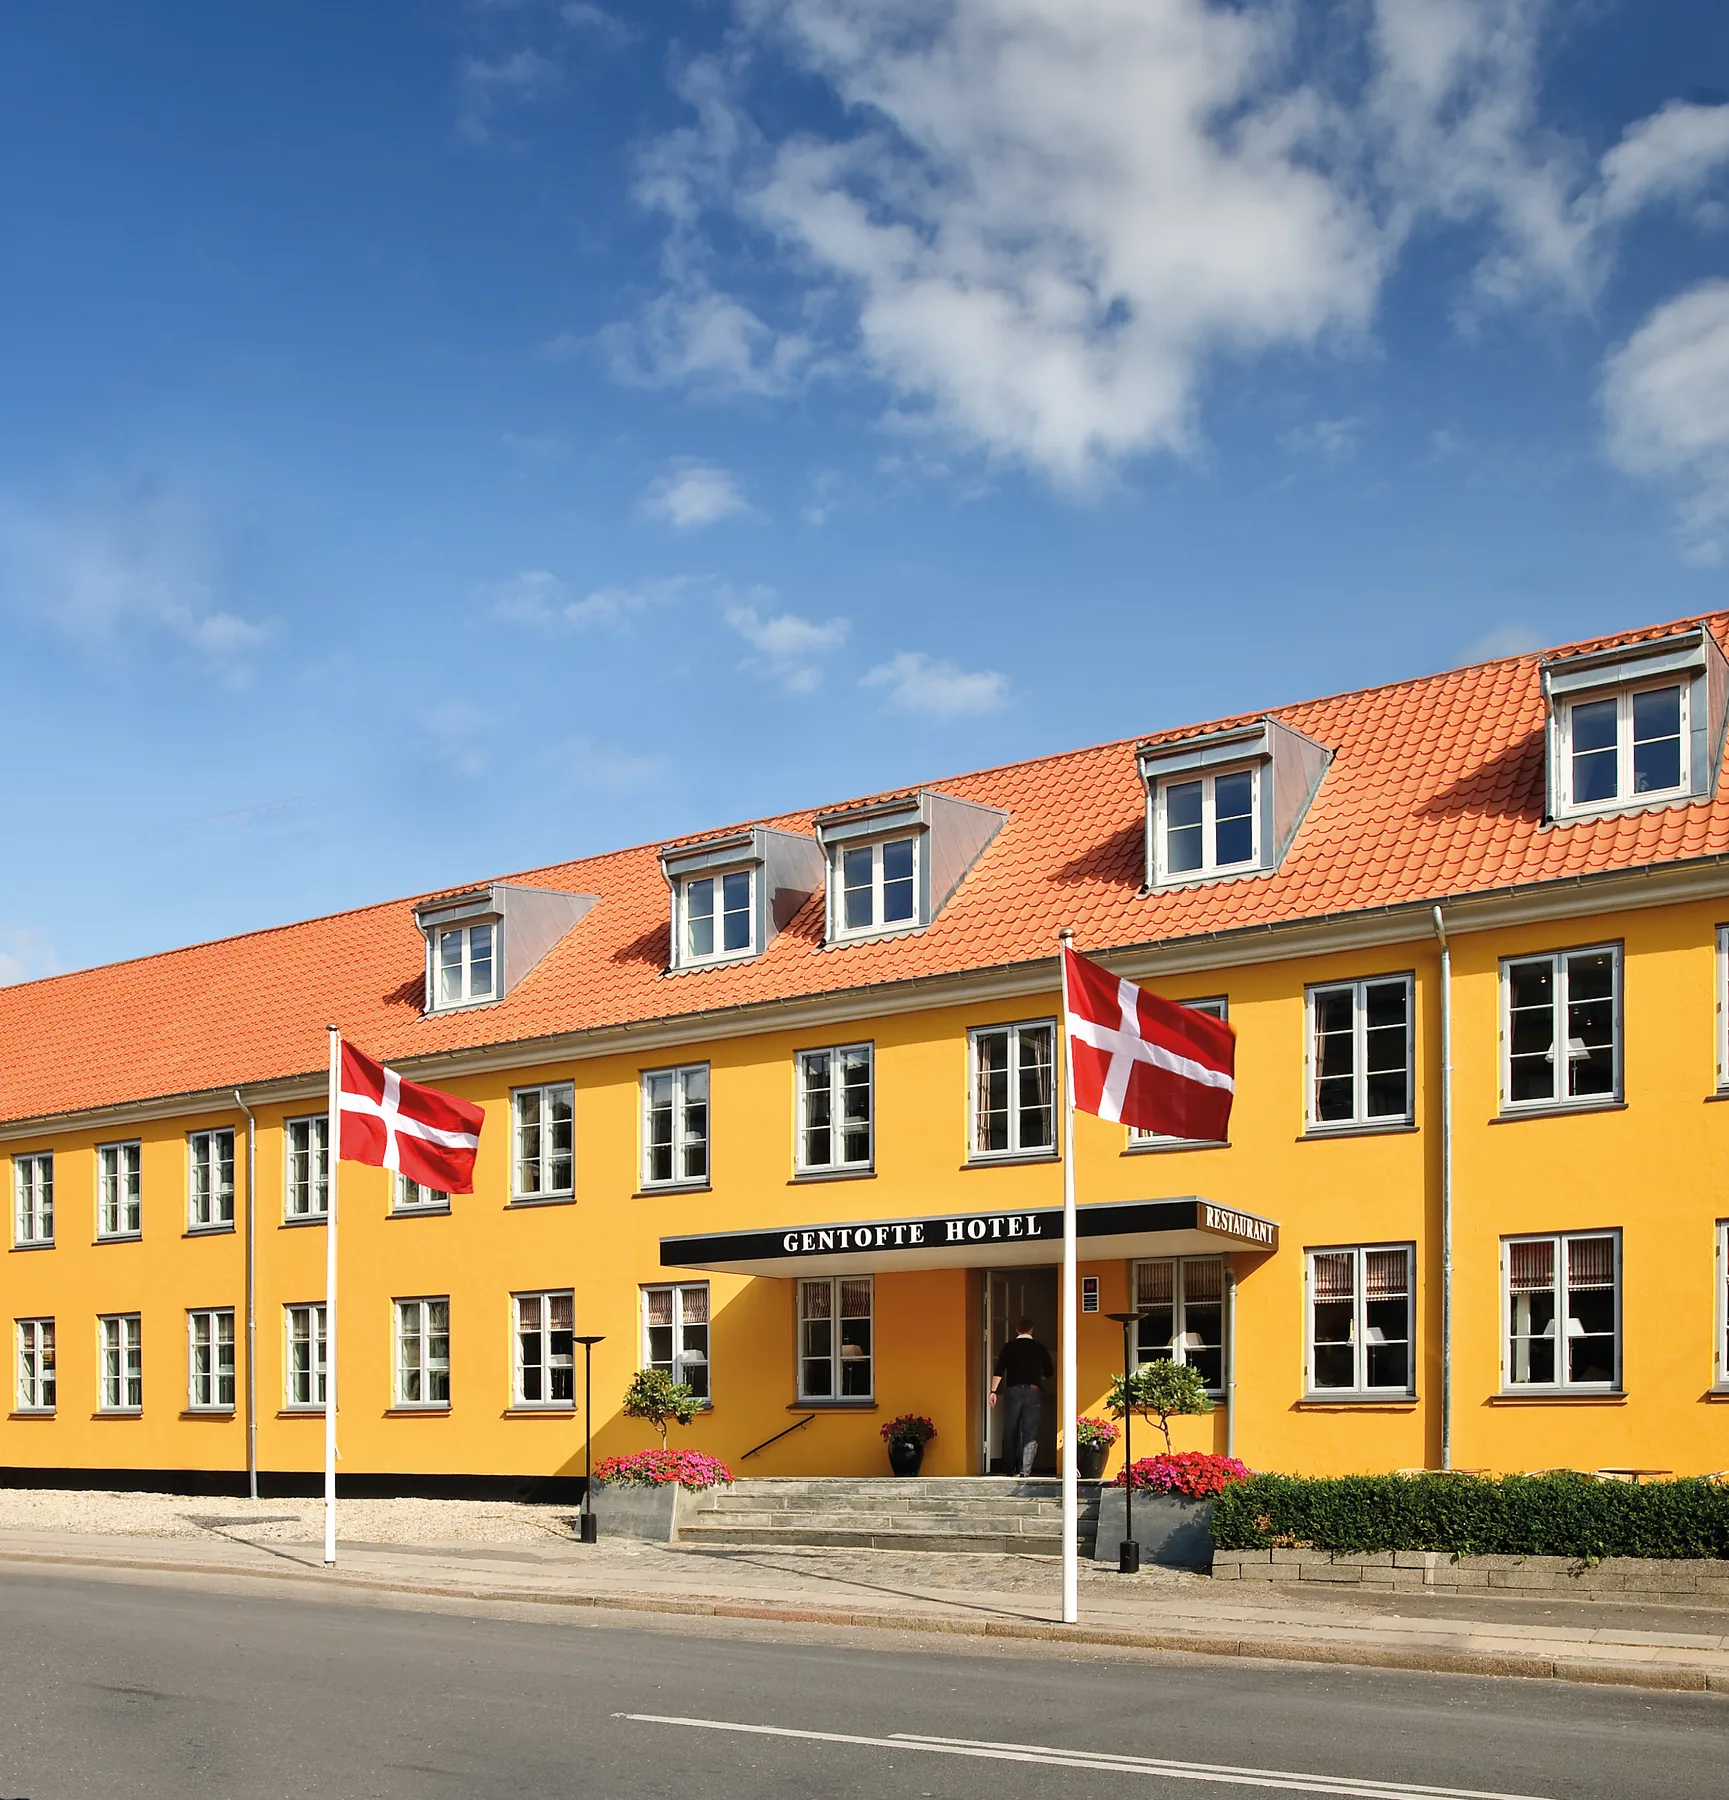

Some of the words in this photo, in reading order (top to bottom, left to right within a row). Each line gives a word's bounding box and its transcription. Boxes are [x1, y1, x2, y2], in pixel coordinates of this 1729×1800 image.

[783, 1223, 925, 1252] GENTOFTE
[945, 1215, 1042, 1241] HOTEL
[1205, 1205, 1273, 1244] RESTAURANT
